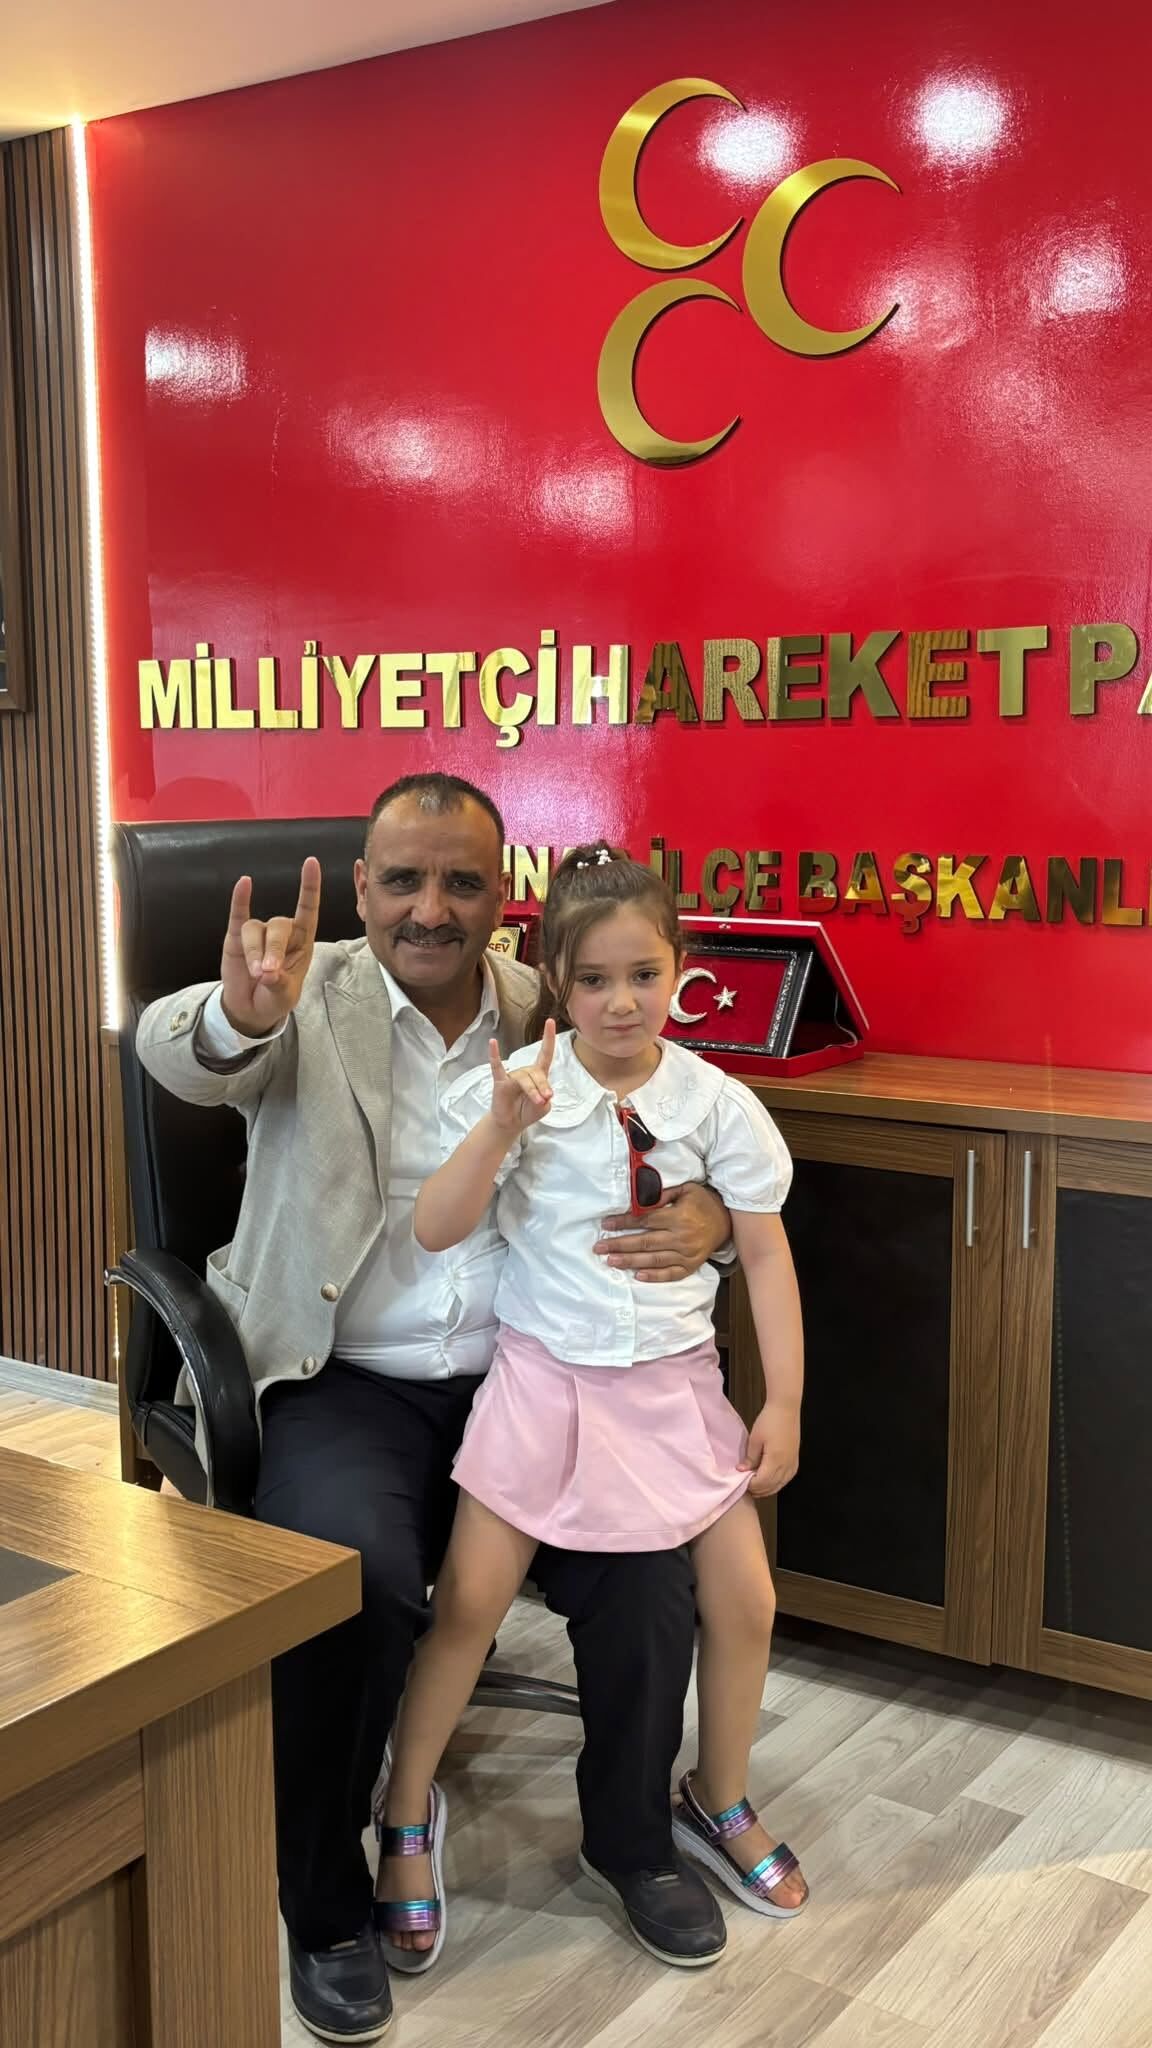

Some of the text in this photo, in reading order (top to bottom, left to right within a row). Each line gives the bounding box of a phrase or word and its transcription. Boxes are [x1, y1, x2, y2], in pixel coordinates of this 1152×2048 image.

[138, 623, 1152, 748] MİLLİYETÇİ HAREKET P
[651, 837, 780, 917] İLÇE
[799, 850, 1152, 934] BAŞKANL
